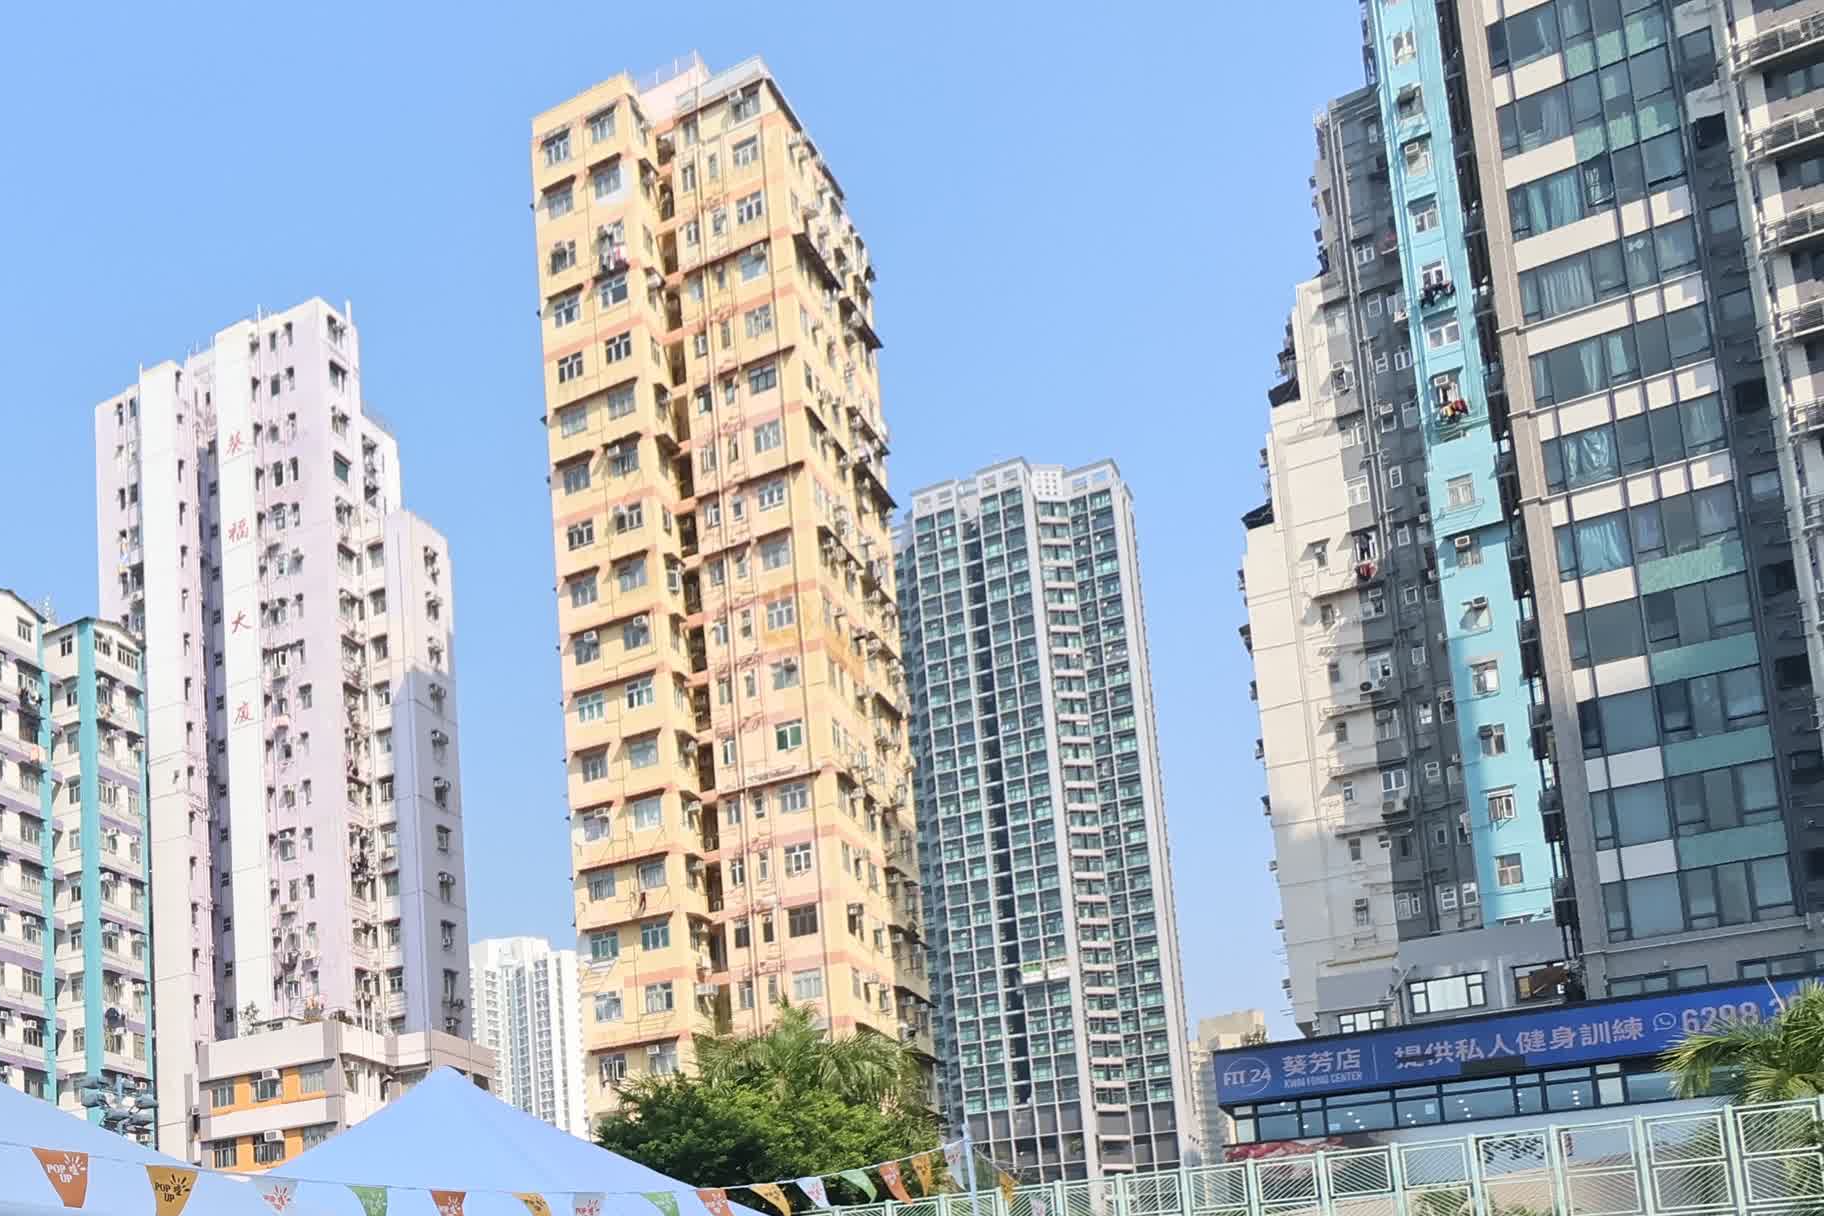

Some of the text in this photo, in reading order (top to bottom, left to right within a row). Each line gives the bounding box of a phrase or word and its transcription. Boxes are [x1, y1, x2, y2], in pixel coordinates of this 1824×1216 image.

[1394, 1016, 1645, 1070] 提供私人健身訓練
[1281, 1048, 1362, 1077] 葵芳店
[1224, 1067, 1272, 1087] FIT 24
[1331, 1070, 1363, 1083] CENTER
[47, 1163, 66, 1175] POP
[58, 1173, 73, 1184] UP
[154, 1181, 171, 1193] POP
[164, 1192, 175, 1203] UP
